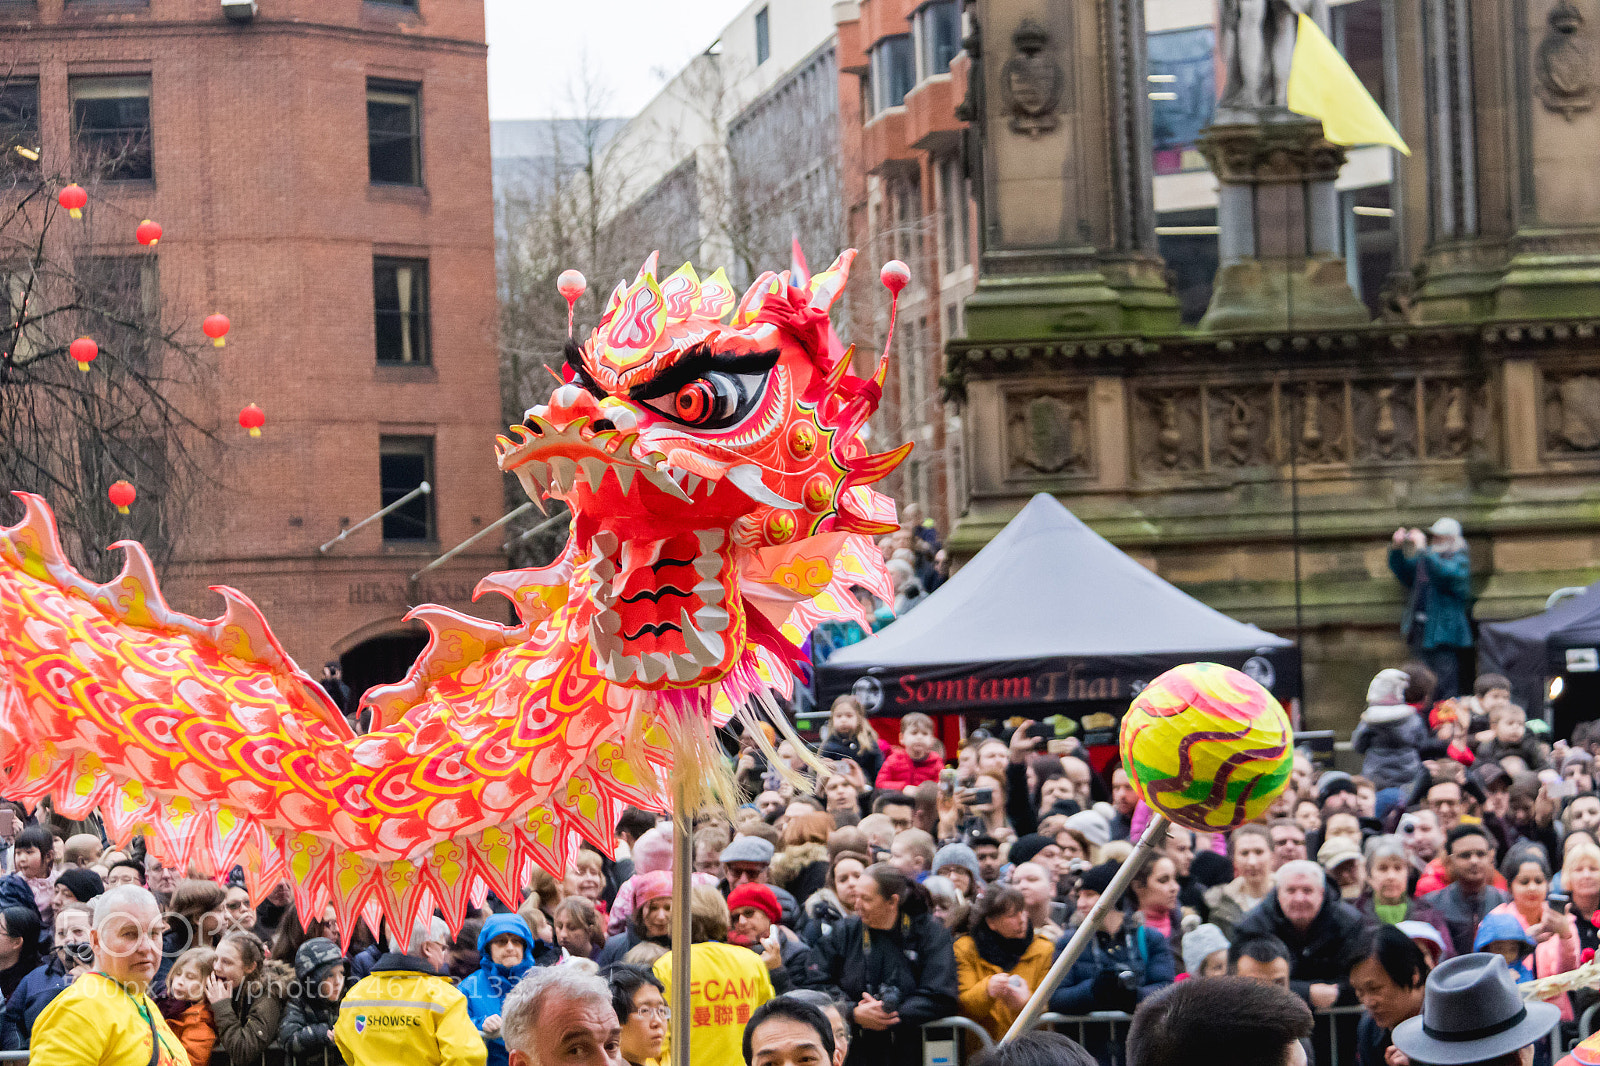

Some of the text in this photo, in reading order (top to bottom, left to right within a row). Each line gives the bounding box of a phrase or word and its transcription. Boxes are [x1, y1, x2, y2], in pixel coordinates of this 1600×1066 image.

[895, 660, 1119, 703] Somtam Thai
[367, 1015, 421, 1027] SHOWSEC
